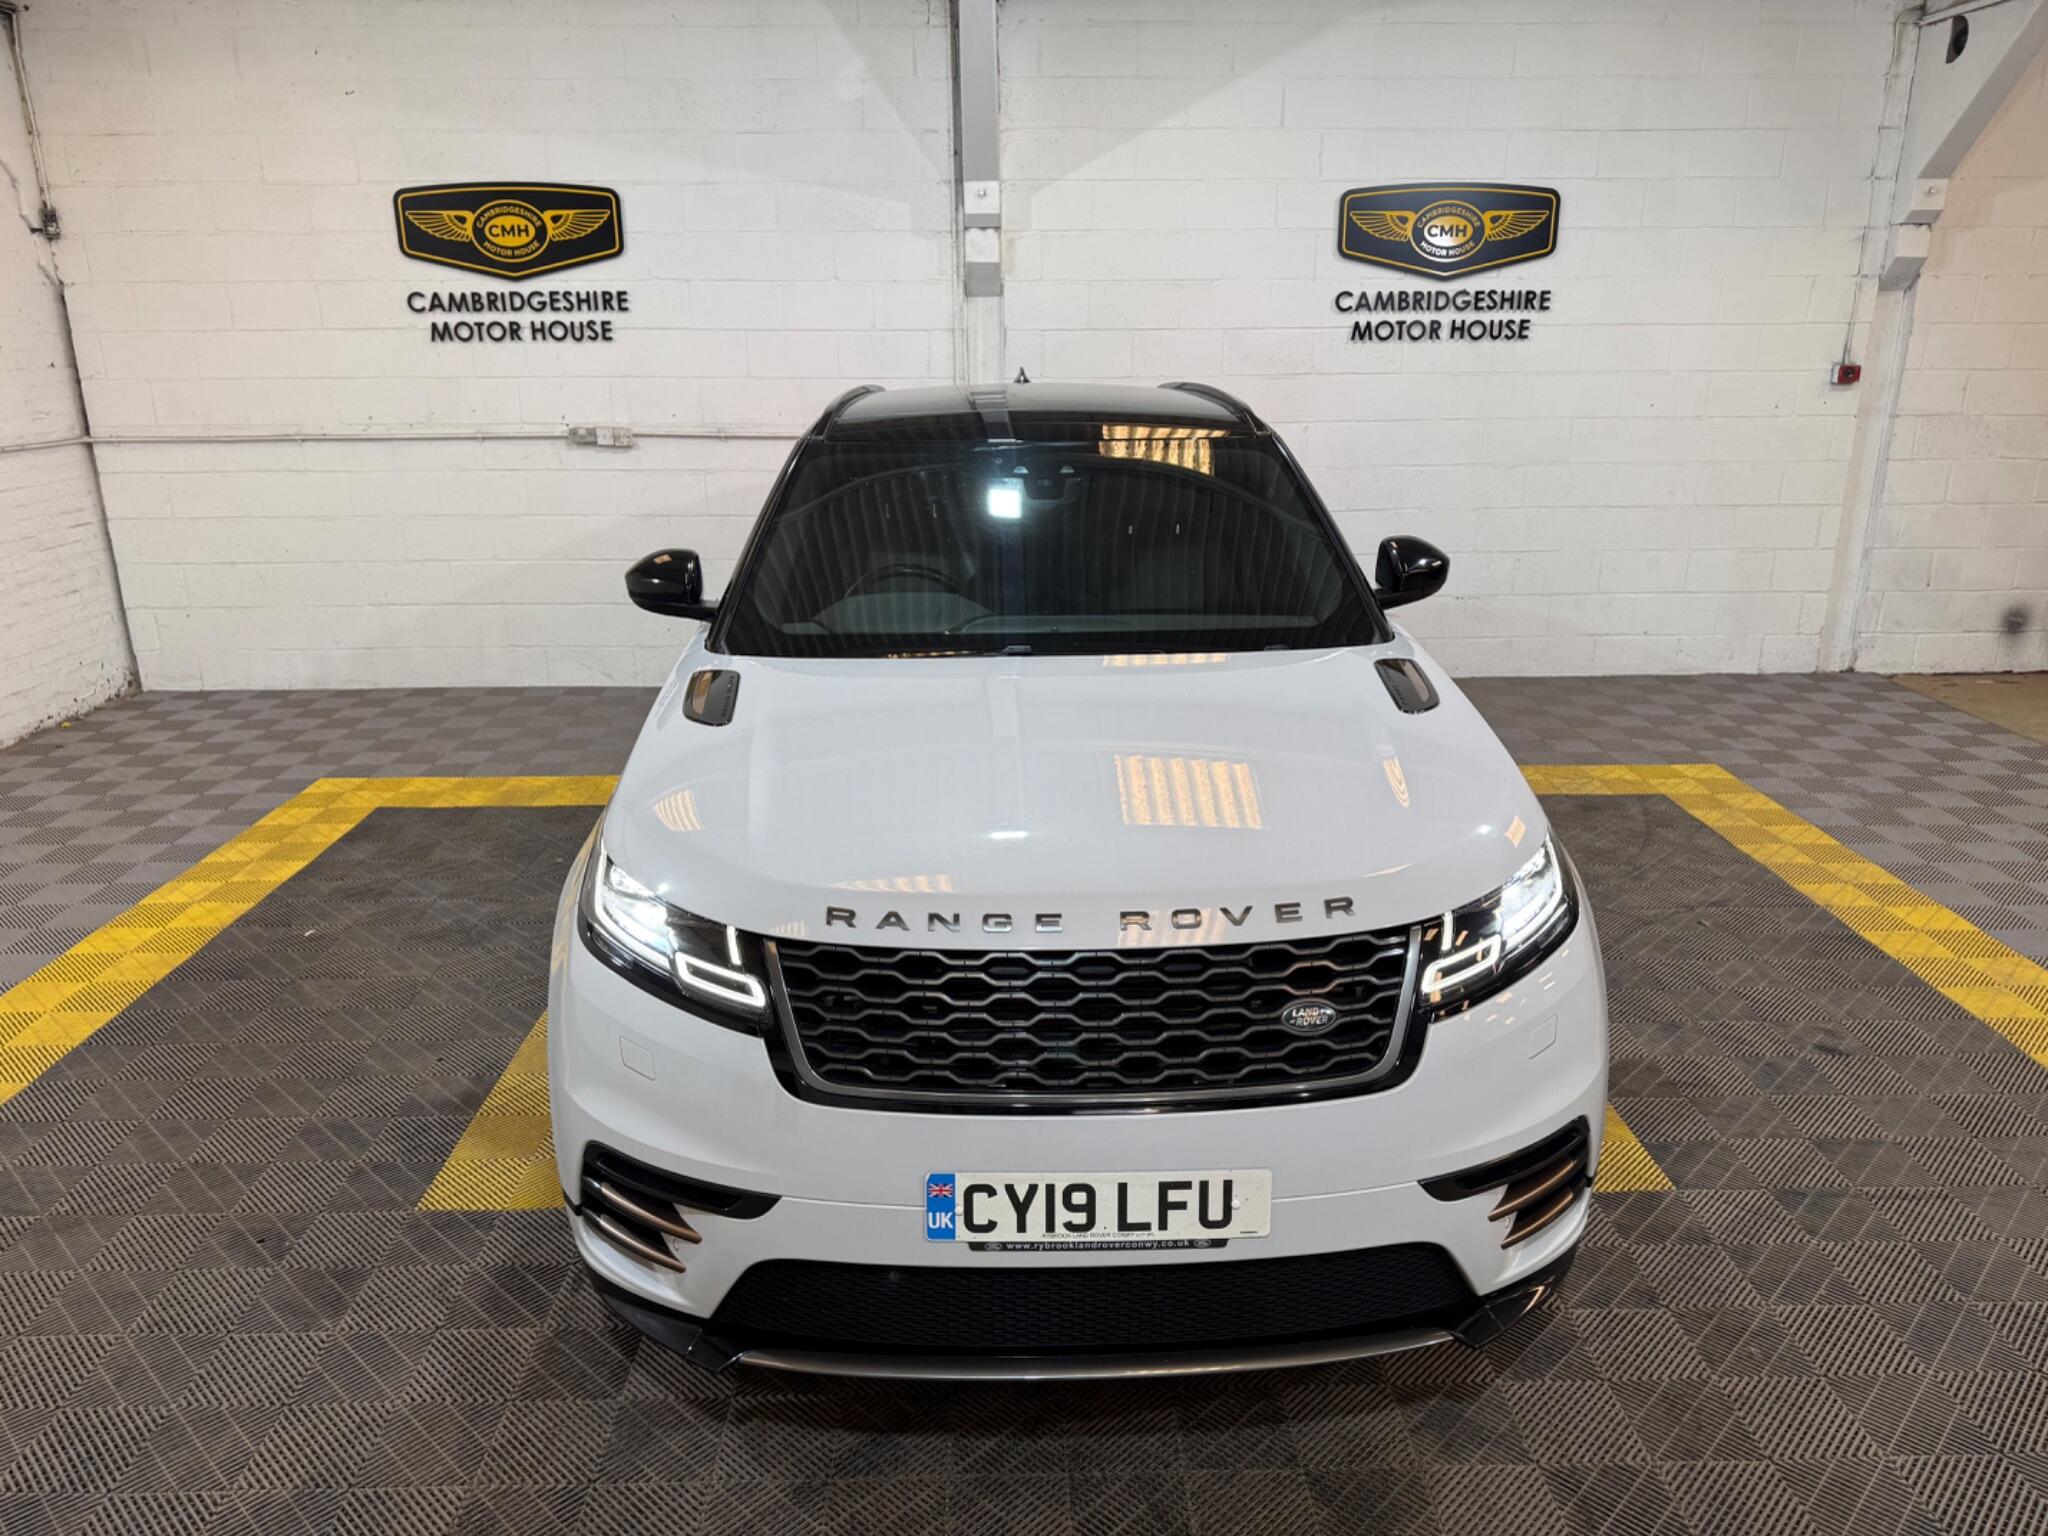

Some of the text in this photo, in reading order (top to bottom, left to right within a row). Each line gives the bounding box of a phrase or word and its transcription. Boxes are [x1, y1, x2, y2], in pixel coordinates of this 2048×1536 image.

[476, 205, 543, 229] CAMBRIDGESHIRE
[1416, 205, 1481, 229] CAMBRIDGESHIRE
[488, 224, 530, 238] CMH
[1426, 224, 1468, 238] CMH
[482, 240, 540, 257] MOTOR HOUSE
[1420, 240, 1475, 257] MOTOR HOUSE
[407, 290, 630, 313] CAMBRIDGESHIRE
[1335, 289, 1552, 313] CAMBRIDGESHIRE
[431, 319, 614, 342] MOTOR HOUSE
[1350, 319, 1531, 341] MOTOR HOUSE
[825, 897, 1355, 934] RANGE ROVER
[1291, 1007, 1319, 1018] LAND
[1295, 1015, 1329, 1026] ROVER
[963, 1180, 1234, 1234] CY19 LFU
[928, 1212, 954, 1231] UK
[1006, 1239, 1190, 1251] www.rybrooklandroverconwy.co.uk
